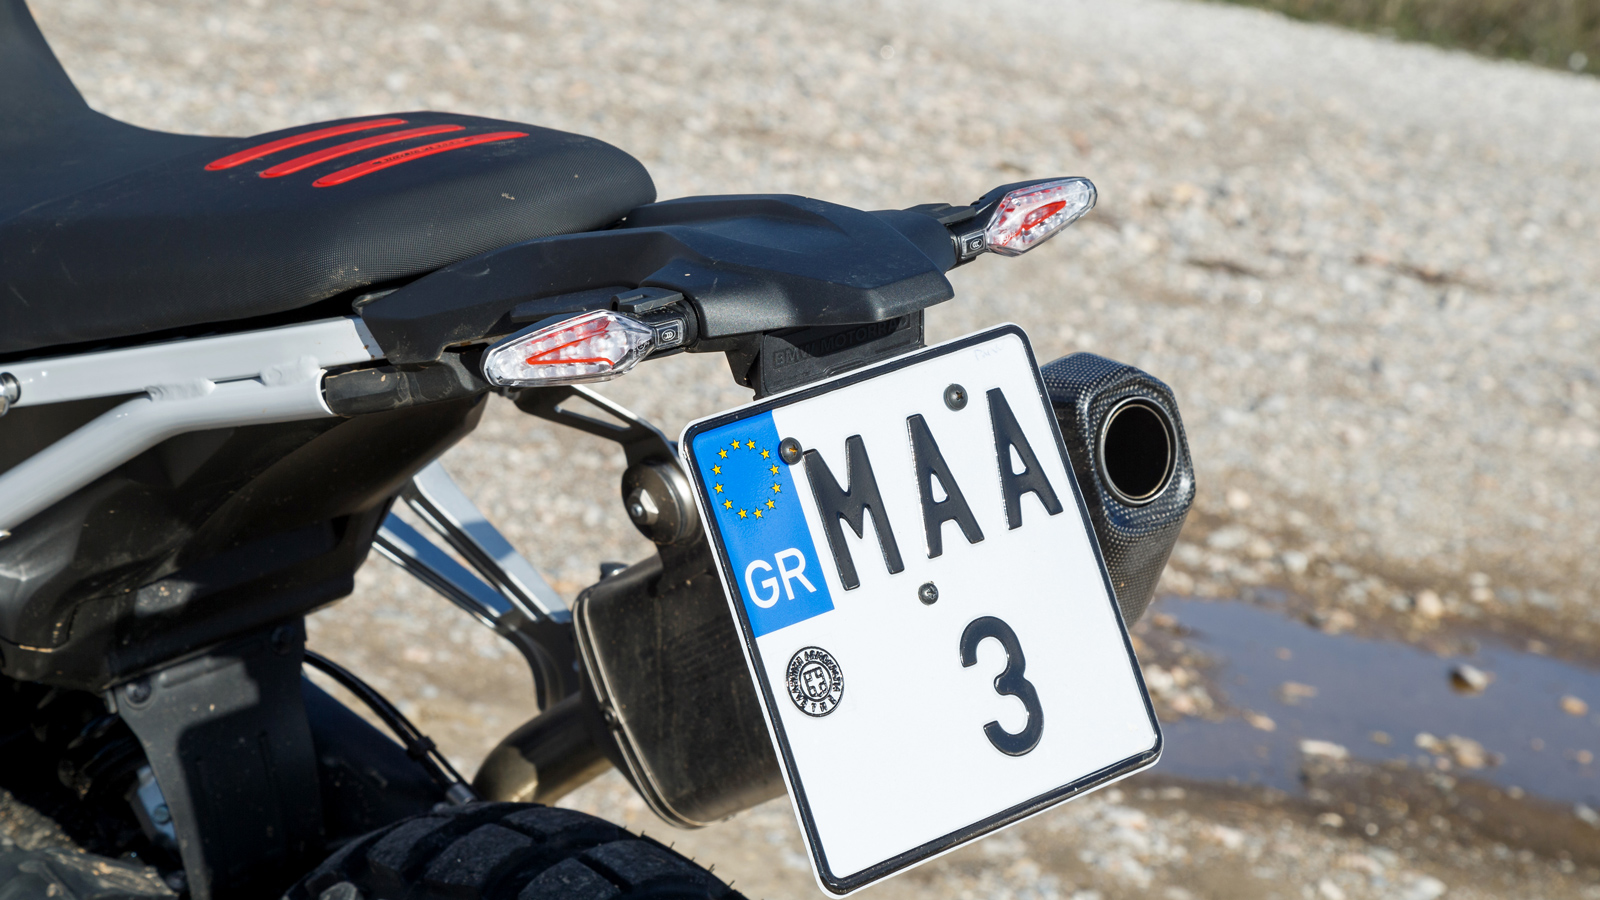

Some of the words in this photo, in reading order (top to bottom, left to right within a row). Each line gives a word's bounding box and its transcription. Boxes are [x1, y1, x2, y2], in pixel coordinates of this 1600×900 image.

[773, 342, 816, 365] BMW
[820, 315, 909, 353] MOTORRAD
[803, 387, 1063, 591] MAA
[745, 547, 817, 609] GR
[960, 616, 1045, 757] 3
